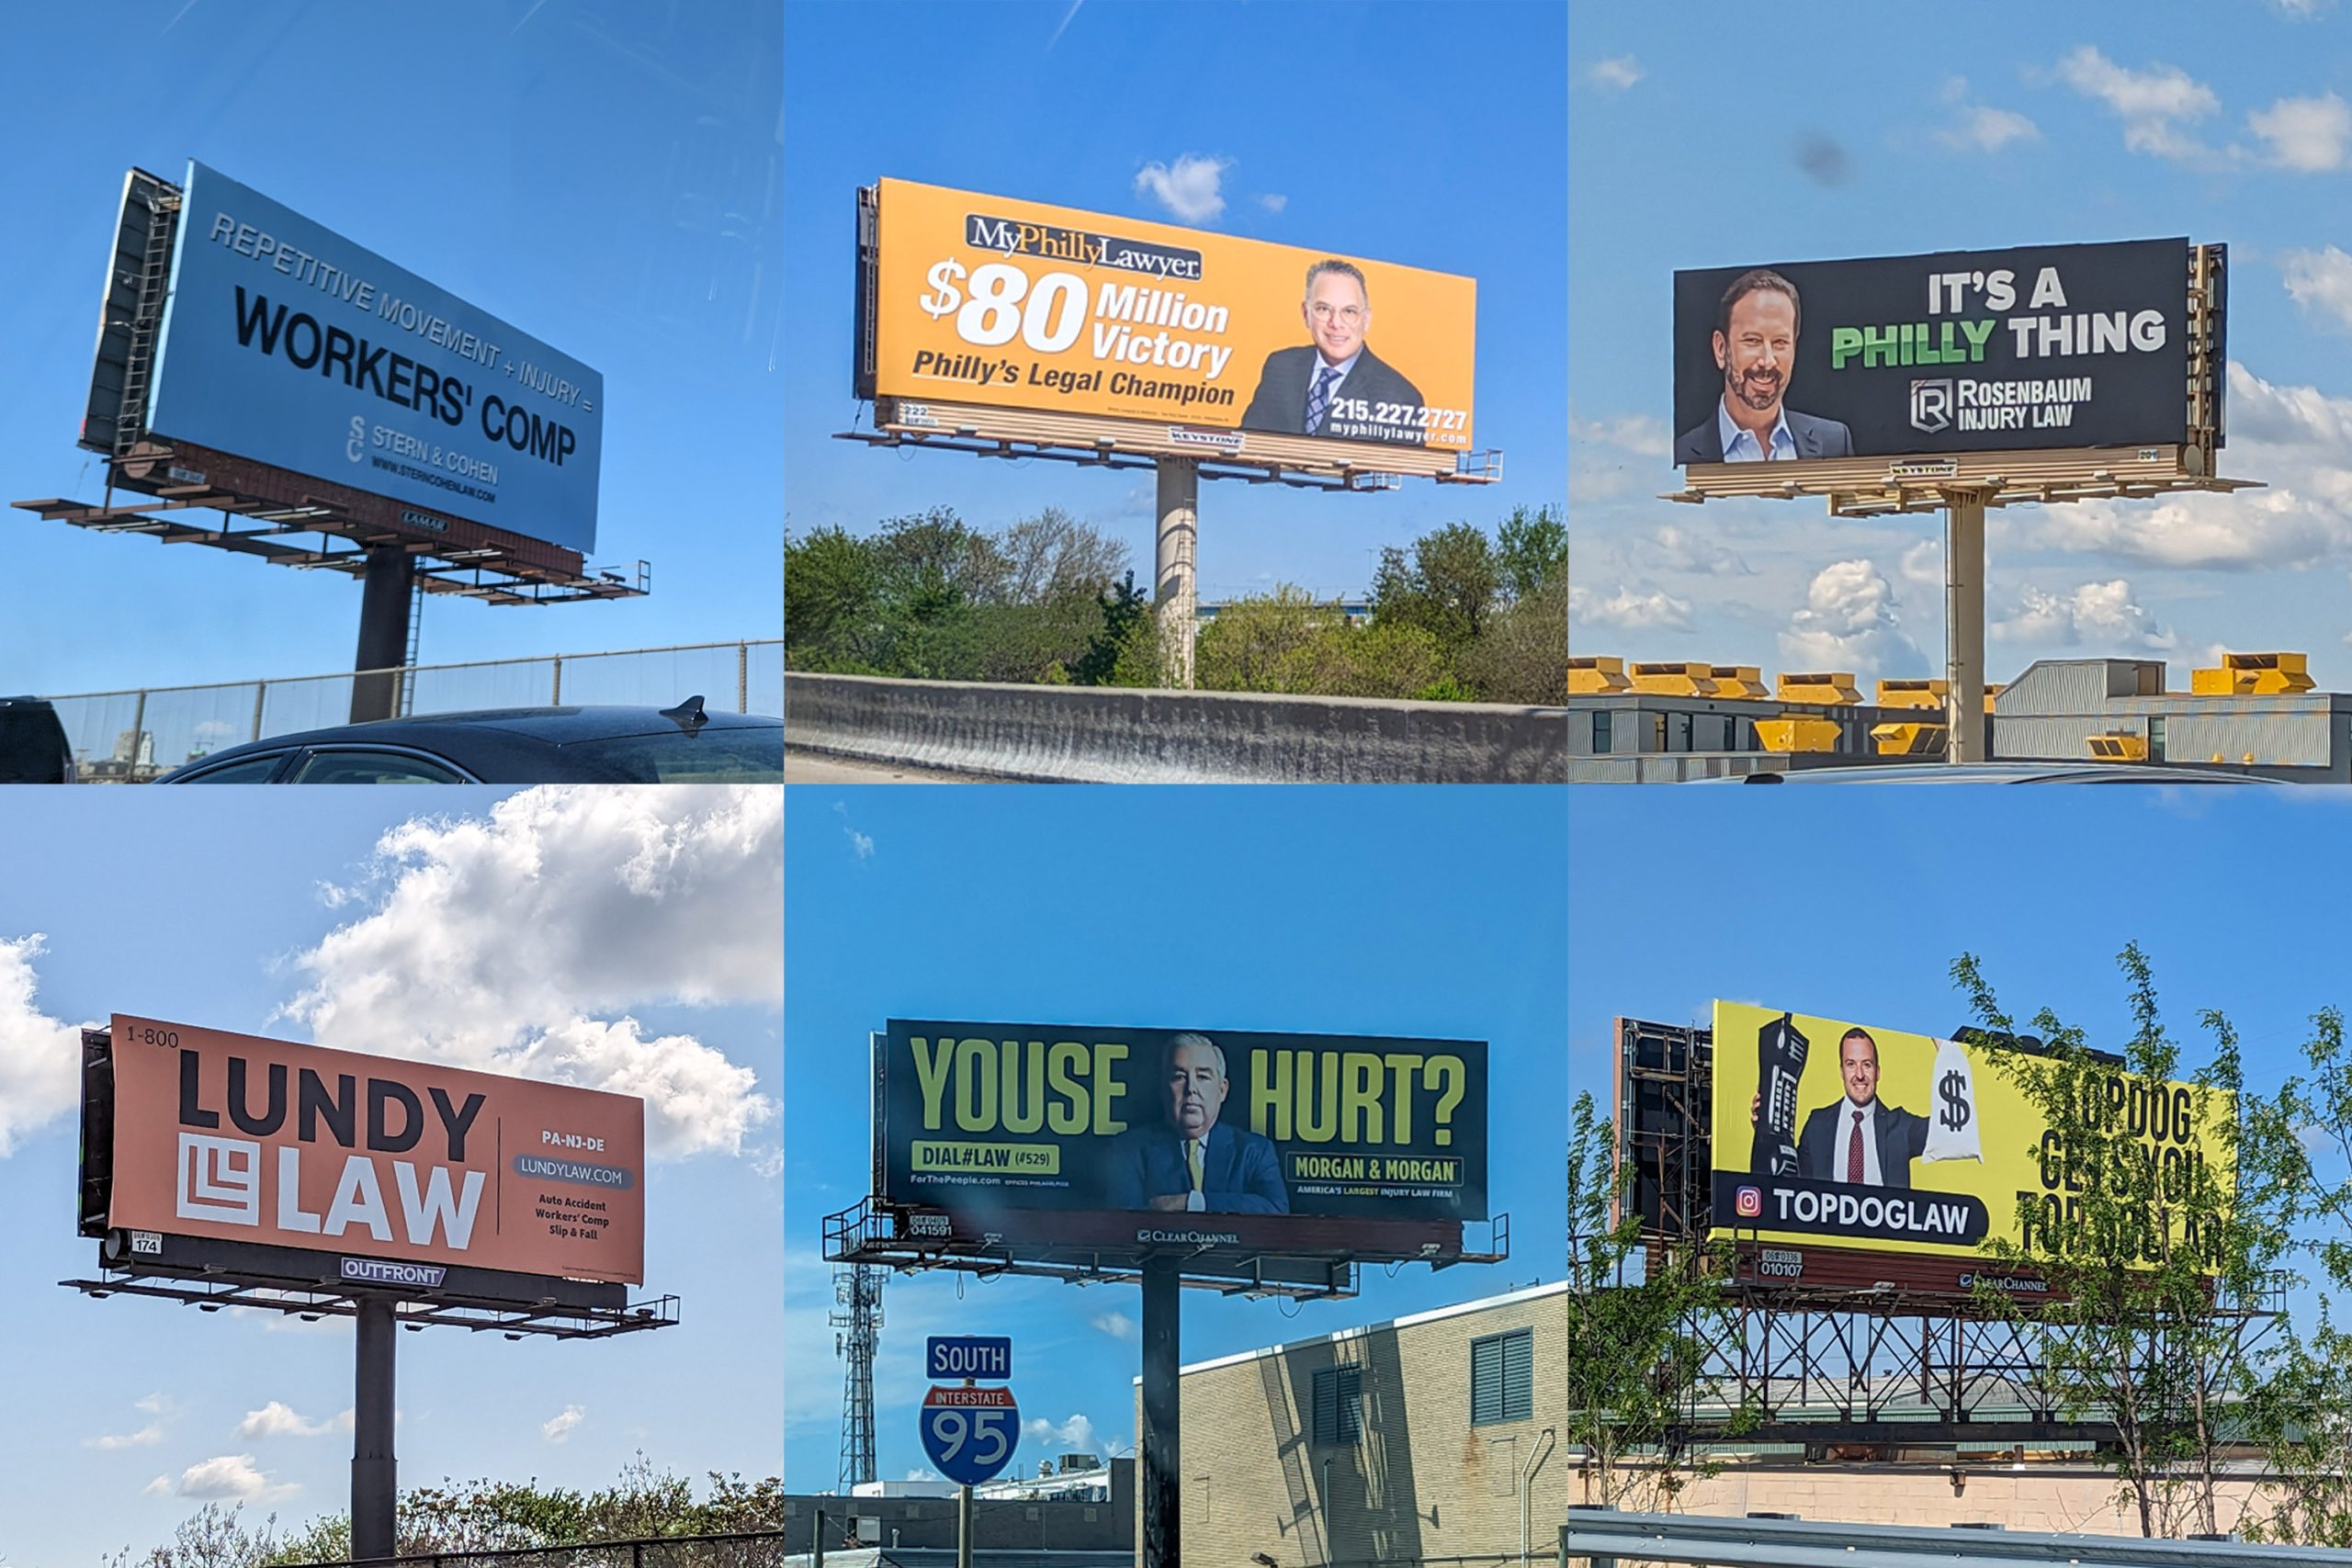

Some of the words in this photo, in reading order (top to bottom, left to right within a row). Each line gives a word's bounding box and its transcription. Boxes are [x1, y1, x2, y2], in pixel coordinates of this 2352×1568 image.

[1928, 268, 2016, 315] IT'S
[2029, 266, 2068, 309] A
[210, 212, 375, 310] REPETITIVE
[378, 293, 502, 369] MOVEMENT
[519, 361, 582, 408] INJURY
[919, 257, 1090, 354] $80
[1095, 282, 1228, 333] Million
[1092, 321, 1233, 379] Victory
[1832, 319, 1996, 369] PHILLY
[2007, 309, 2166, 358] THING
[234, 285, 472, 427] WORKERS'
[481, 394, 576, 467] COMP
[912, 350, 1020, 386] Philly's
[1028, 362, 1102, 393] Legal
[1110, 372, 1235, 406] Champion
[1330, 397, 1467, 431] 215.227.2727
[1958, 407, 2027, 432] INJURY
[2032, 404, 2073, 429] LAW
[1171, 432, 1241, 445] KEYSTONE
[1329, 422, 1467, 445] myphillylawyer.com
[371, 425, 430, 463] STERN
[433, 446, 443, 468] &
[446, 451, 500, 487] COHEN
[371, 455, 496, 503] WWW.STERNCOHENLAW.COM
[127, 1025, 179, 1048] 1-800
[910, 1037, 1129, 1135] YOUSE
[1250, 1049, 1465, 1146] HURT?
[179, 1049, 487, 1163] LUNDY
[542, 1130, 605, 1152] PA-NJ-DE
[922, 1146, 1011, 1168] DIAL#LAW
[1295, 1156, 1364, 1179] MORGAN
[1369, 1158, 1382, 1180] &
[1385, 1159, 1455, 1182] MORGAN
[521, 1158, 622, 1184] LUNDYLAW.COM
[910, 1174, 1001, 1187] ForThePeople.com
[277, 1145, 487, 1250] LAW
[538, 1194, 562, 1205] Auto
[564, 1198, 606, 1212] Accident
[1297, 1185, 1341, 1195] AMERICA'S
[1343, 1187, 1378, 1196] LARGEST
[1380, 1188, 1409, 1198] INJURY
[1411, 1189, 1431, 1198] LAW
[1432, 1190, 1453, 1199] FIRM
[536, 1208, 580, 1223] Workers'
[582, 1214, 609, 1229] Comp
[1773, 1189, 1970, 1235] TOPDOGLAW
[549, 1224, 568, 1238] Slip
[570, 1227, 577, 1237] &
[580, 1229, 598, 1239] Fall
[910, 1225, 952, 1236] 041591
[137, 1240, 157, 1252] 174
[345, 1260, 440, 1284] OUTFRONT
[1761, 1262, 1804, 1277] 010107
[934, 1344, 1005, 1372] SOUTH
[935, 1392, 1004, 1405] INTERSTATE
[933, 1410, 1008, 1465] 95
